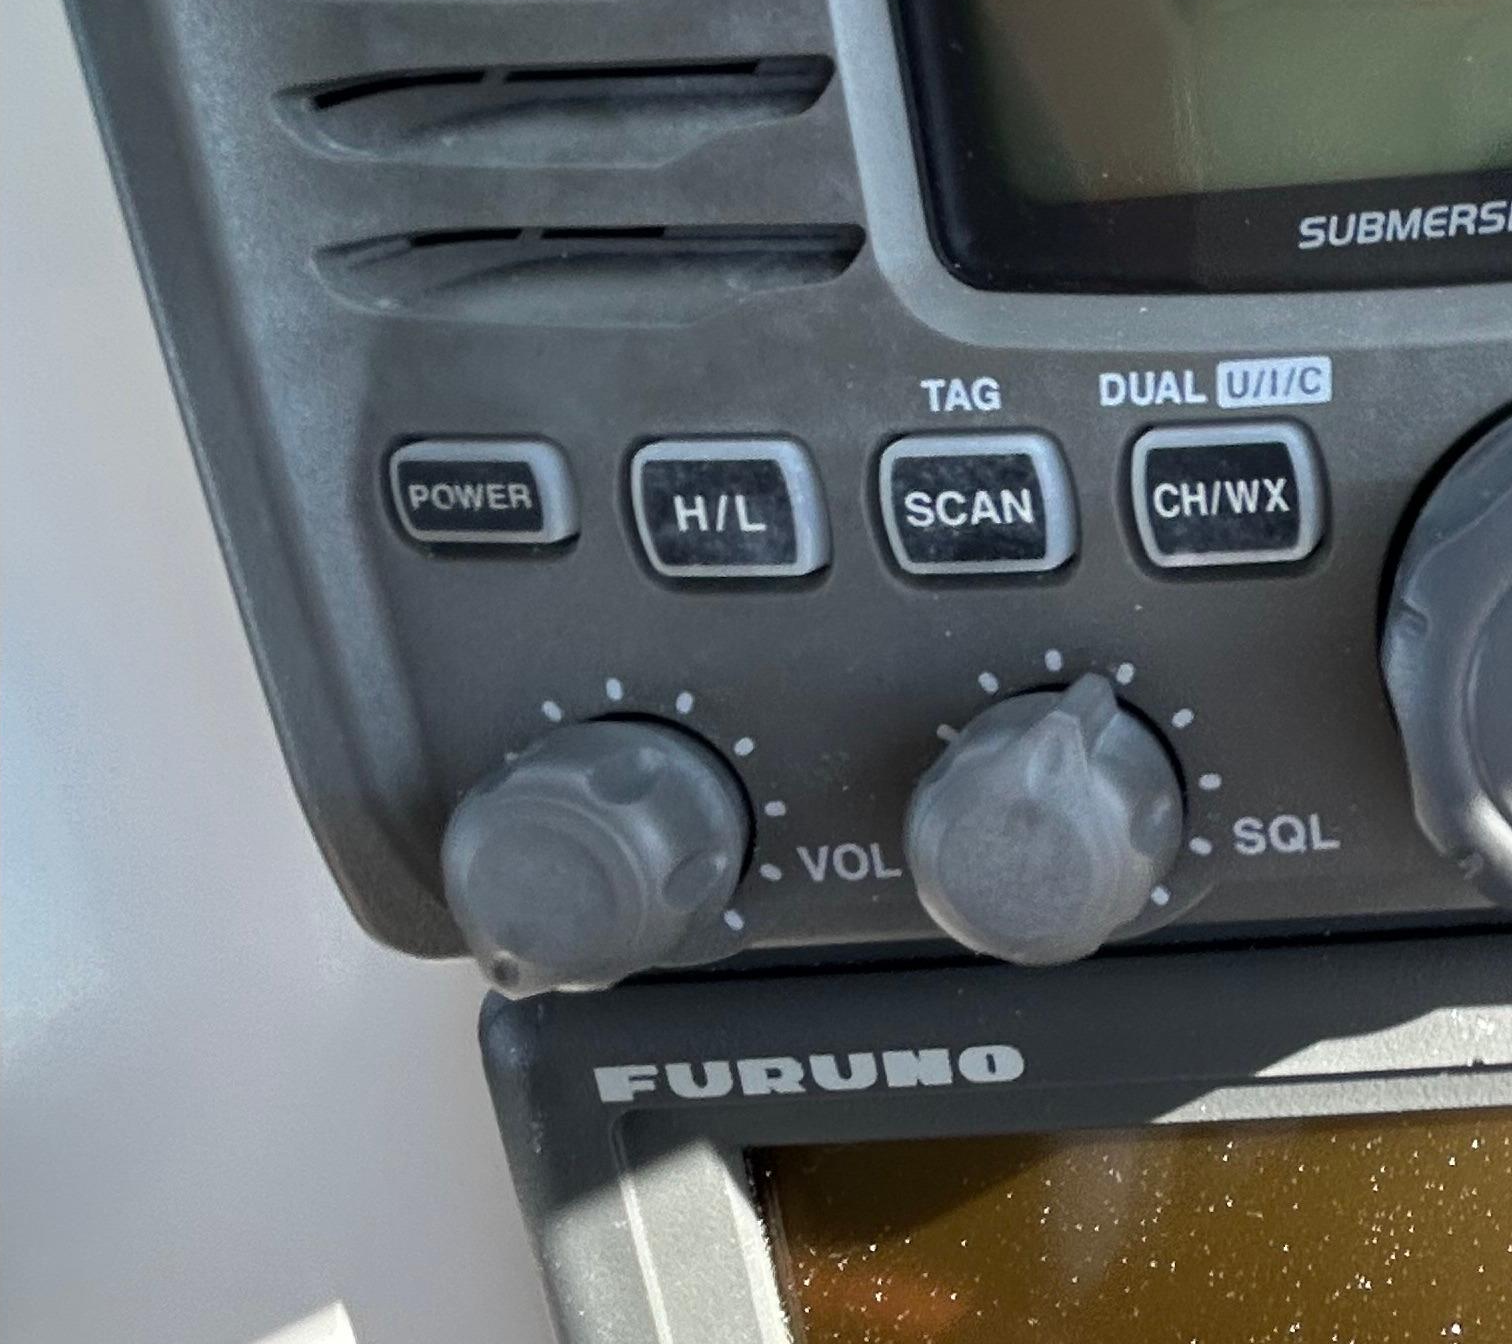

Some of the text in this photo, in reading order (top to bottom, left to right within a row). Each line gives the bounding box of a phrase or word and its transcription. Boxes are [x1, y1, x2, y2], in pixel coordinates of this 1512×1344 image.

[920, 375, 1002, 413] TAG
[1098, 365, 1323, 408] DUAL U/I/C
[407, 482, 533, 512] POWER
[672, 493, 768, 534] H/L
[903, 487, 1036, 529] SCAN
[1152, 477, 1292, 520] CH/WX
[1233, 812, 1341, 856] SQL
[796, 842, 903, 884] VOL
[593, 1043, 1026, 1104] FURUNO
